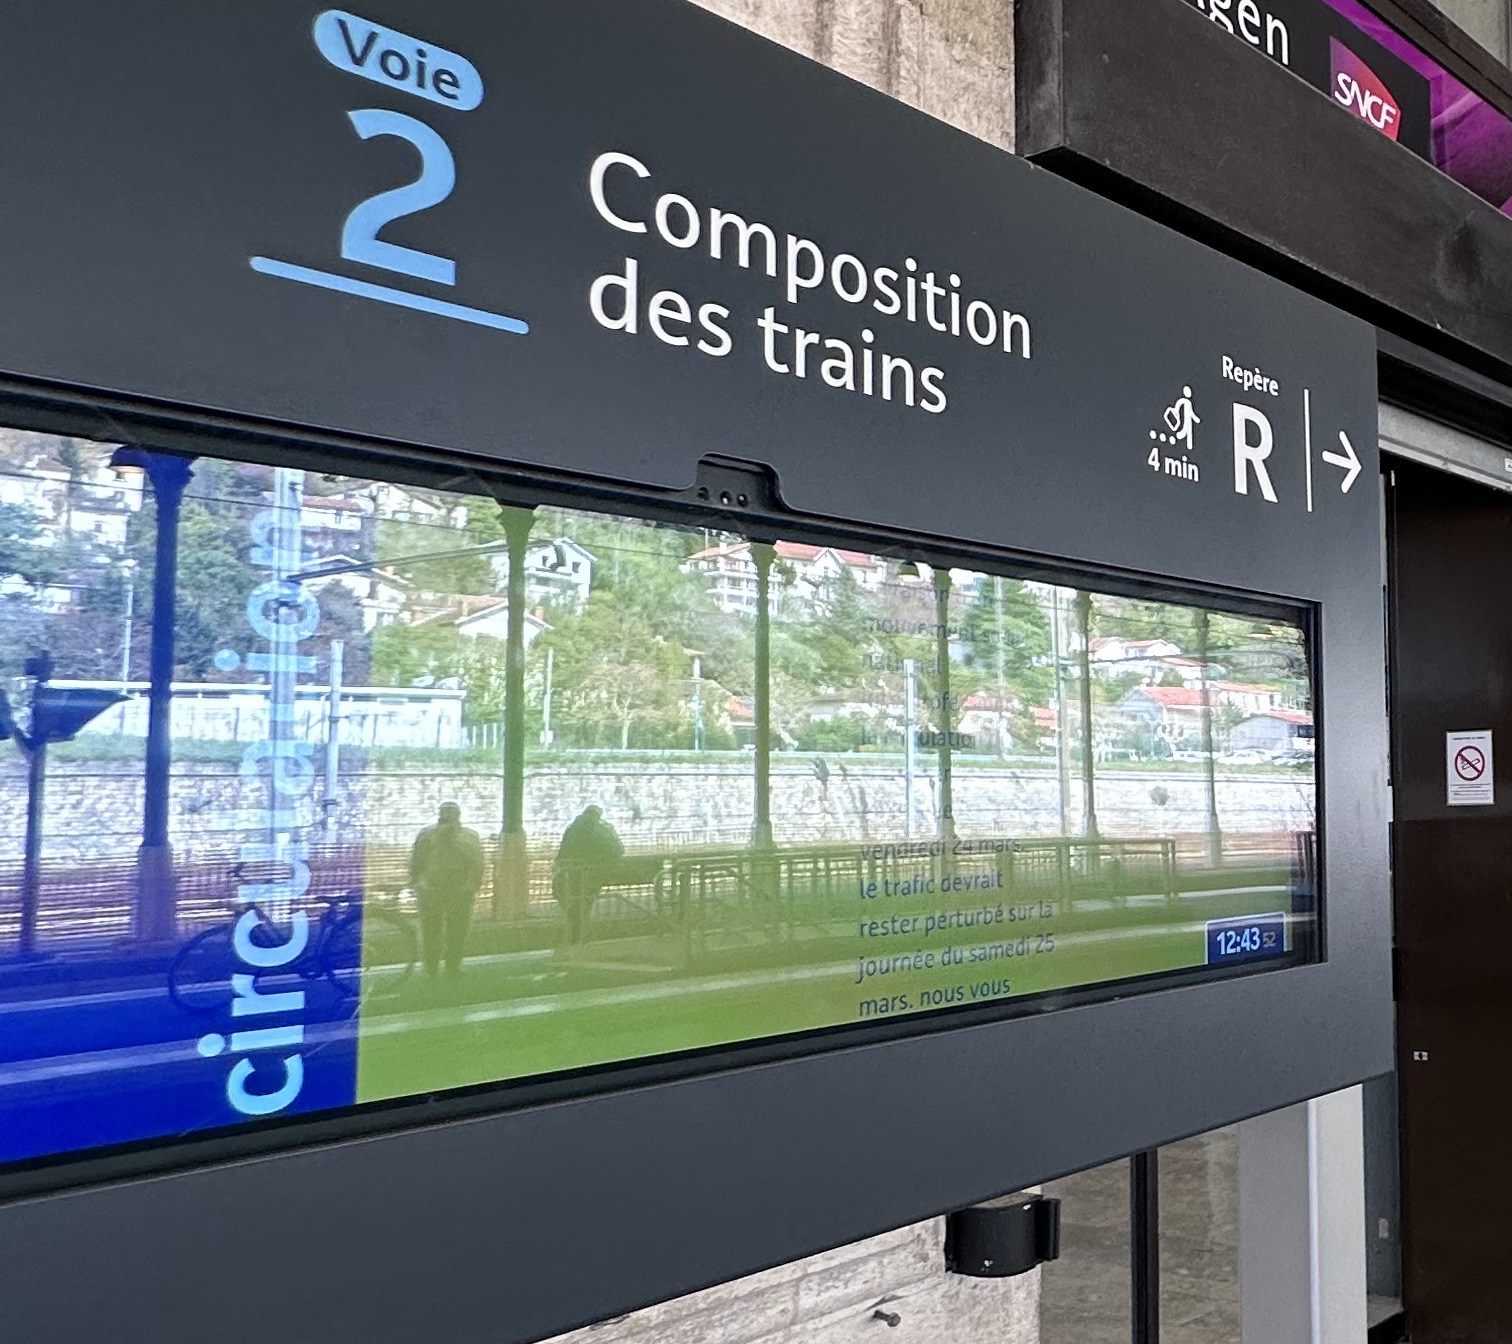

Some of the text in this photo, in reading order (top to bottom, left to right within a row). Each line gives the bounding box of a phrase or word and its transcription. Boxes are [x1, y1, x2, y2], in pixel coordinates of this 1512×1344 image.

[338, 19, 462, 100] Voie
[1334, 72, 1396, 130] SNCF
[340, 108, 455, 286] 2
[588, 151, 1031, 359] Composition
[589, 258, 947, 416] des trains
[1222, 355, 1279, 396] Repère
[1148, 447, 1199, 482] 4 min
[1232, 402, 1278, 504] R
[861, 838, 945, 859] vendredi
[952, 839, 973, 855] 24
[860, 871, 1004, 900] le trafic devrait
[859, 899, 1053, 938] rester perturbé sur la
[1217, 927, 1260, 955] 12:43
[855, 933, 1055, 984] journée du samedi 25
[920, 985, 964, 1007] nous
[970, 978, 1011, 998] vous
